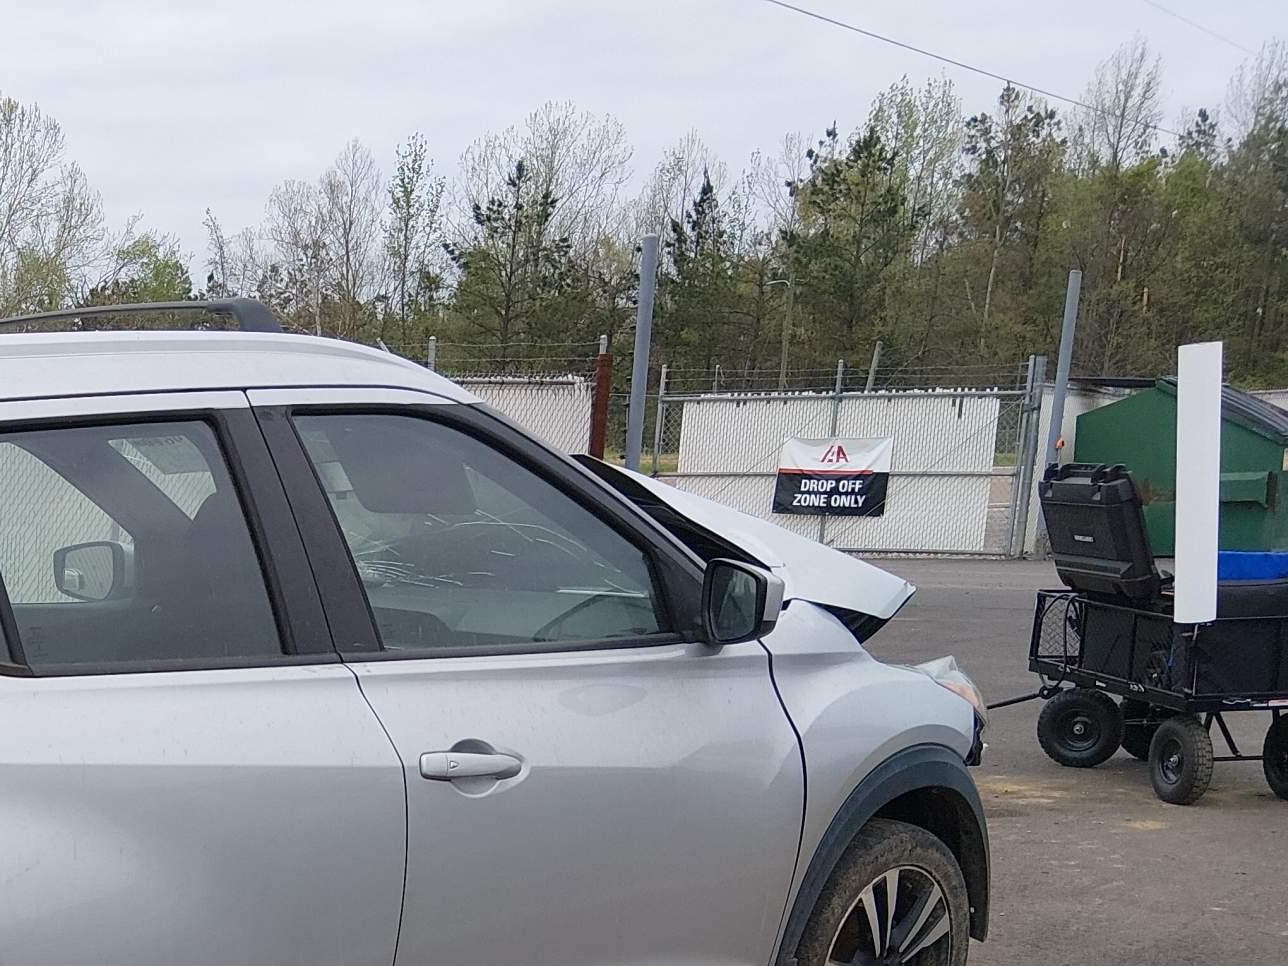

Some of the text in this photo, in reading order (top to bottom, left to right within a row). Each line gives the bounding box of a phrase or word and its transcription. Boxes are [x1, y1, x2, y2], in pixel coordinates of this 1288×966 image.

[800, 479, 863, 492] DROP OFF
[792, 493, 866, 508] ZONE ONLY
